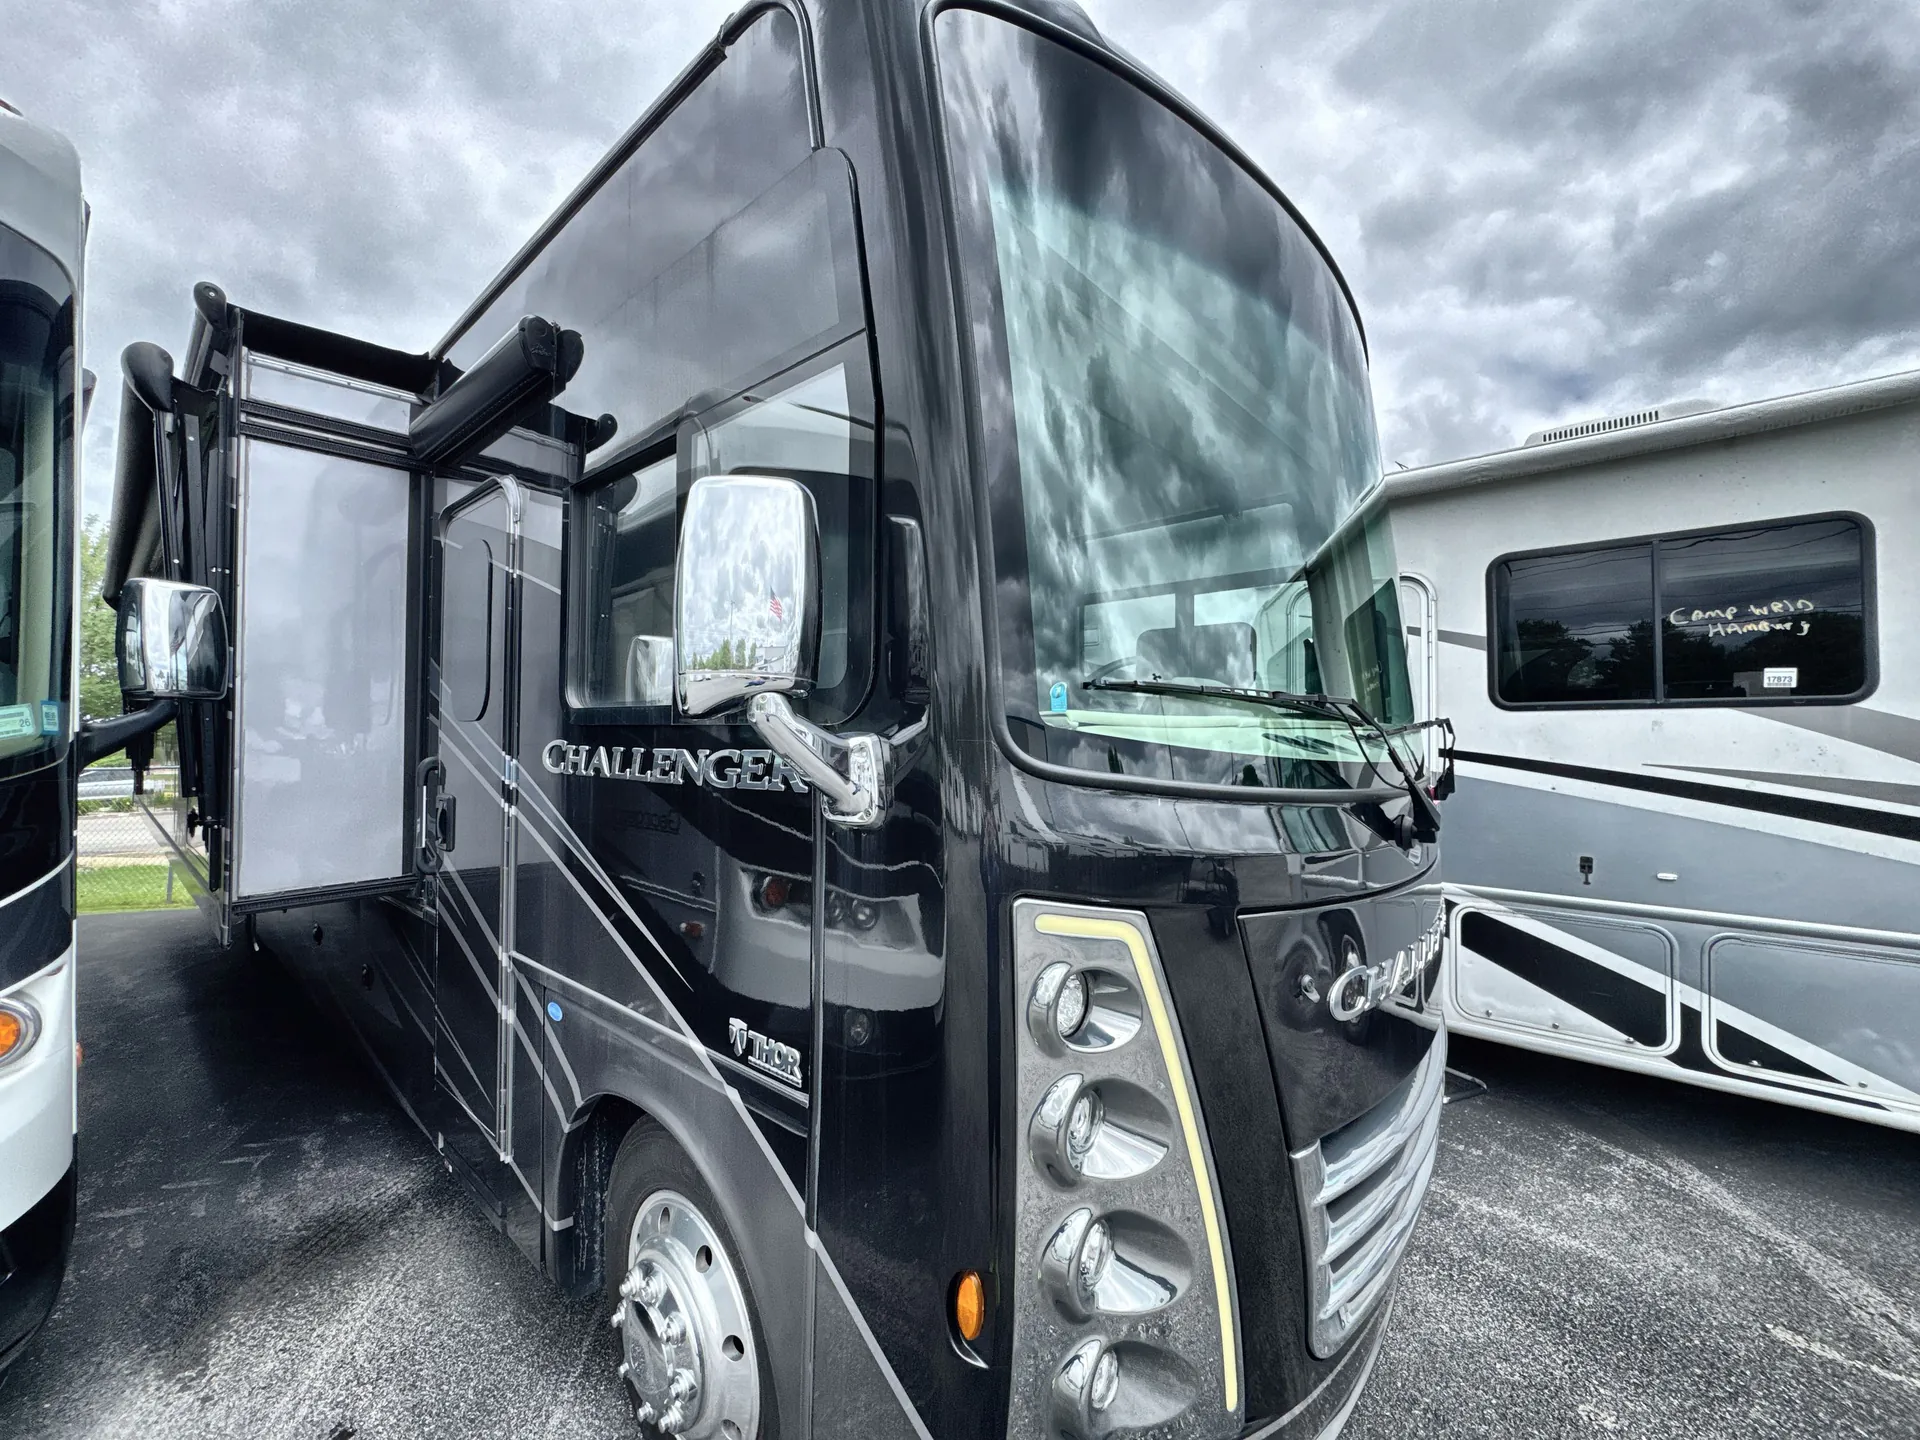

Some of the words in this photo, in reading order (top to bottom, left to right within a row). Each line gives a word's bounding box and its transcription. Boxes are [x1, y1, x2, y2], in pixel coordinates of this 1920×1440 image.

[1766, 675, 1793, 683] 17873
[19, 718, 31, 728] 26
[542, 739, 809, 793] CHALLENGER
[748, 1029, 803, 1080] THOR
